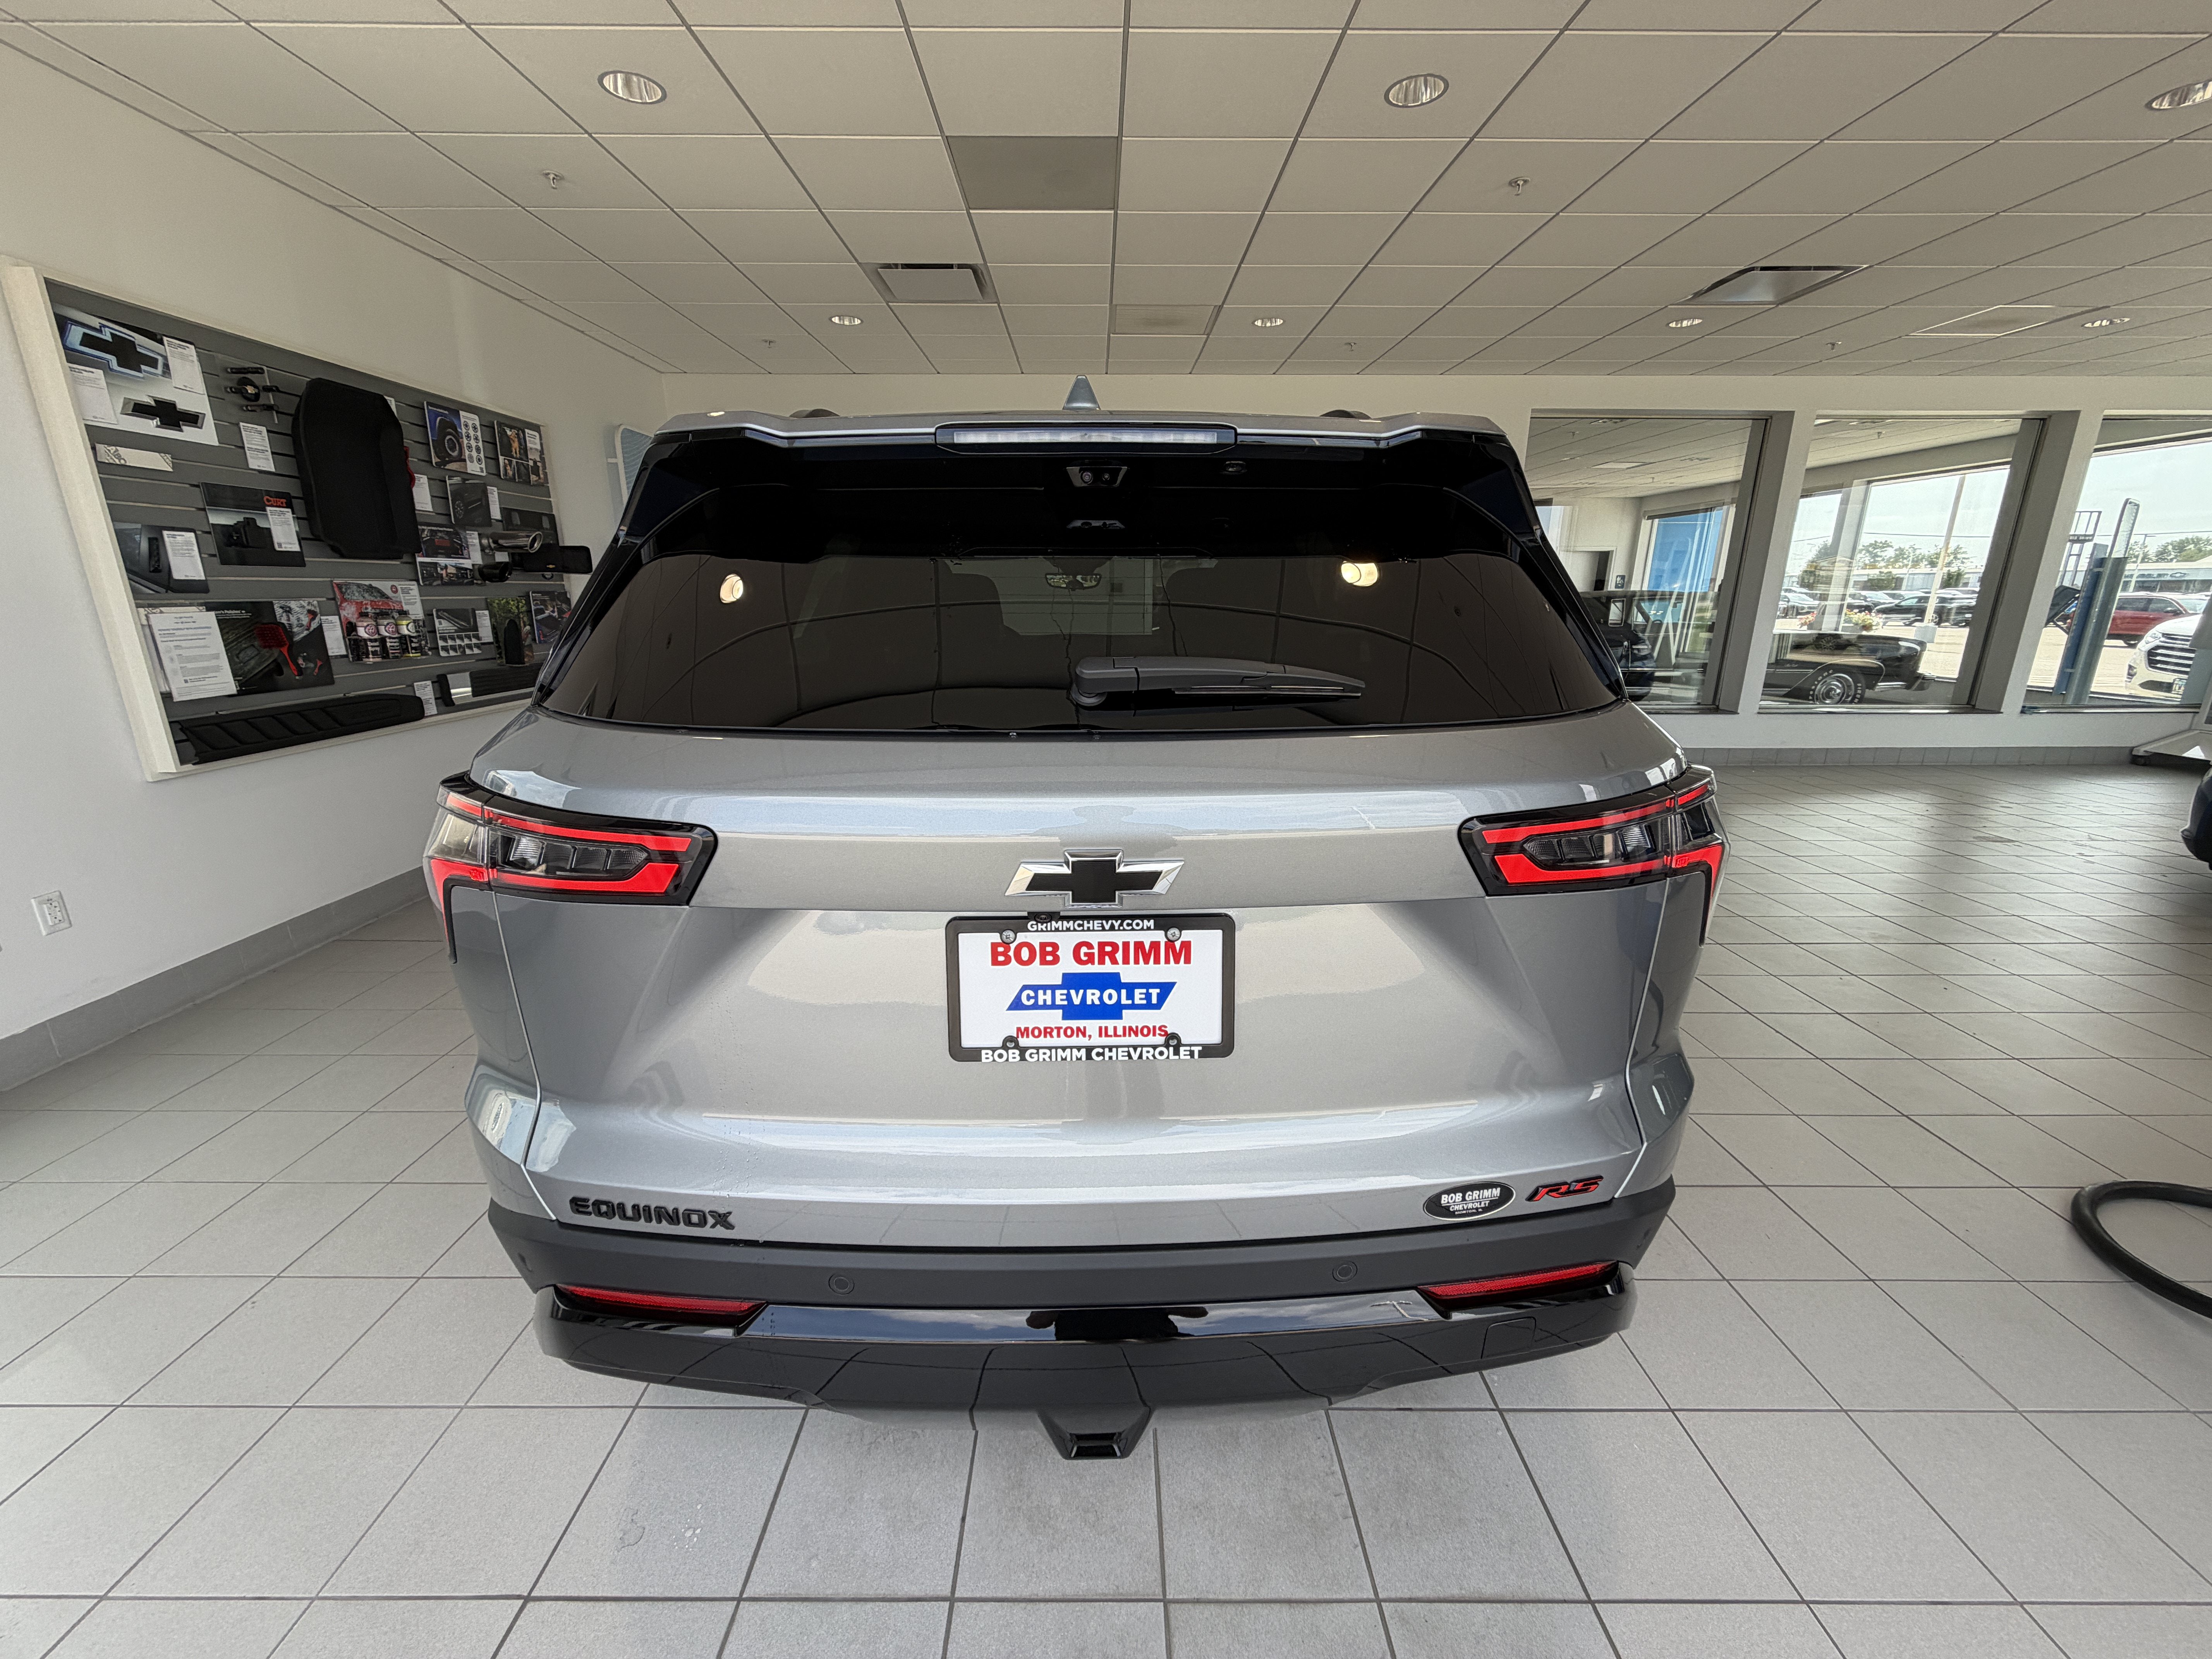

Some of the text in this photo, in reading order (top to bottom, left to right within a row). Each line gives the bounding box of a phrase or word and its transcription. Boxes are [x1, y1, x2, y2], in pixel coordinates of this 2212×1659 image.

[1027, 919, 1154, 931] GRIMMCHEVY.COM
[991, 941, 1192, 967] BOB GRIMM
[1021, 988, 1161, 1006] CHEVROLET
[1016, 1025, 1169, 1041] MORTON, ILLINOIS
[981, 1047, 1202, 1063] BOB GRIMM CHEVROLET
[1441, 1187, 1501, 1204] BOB GRIMM
[1525, 1175, 1604, 1202] RS
[569, 1197, 735, 1230] EQUINOX
[1449, 1200, 1490, 1211] CHEVROLET
